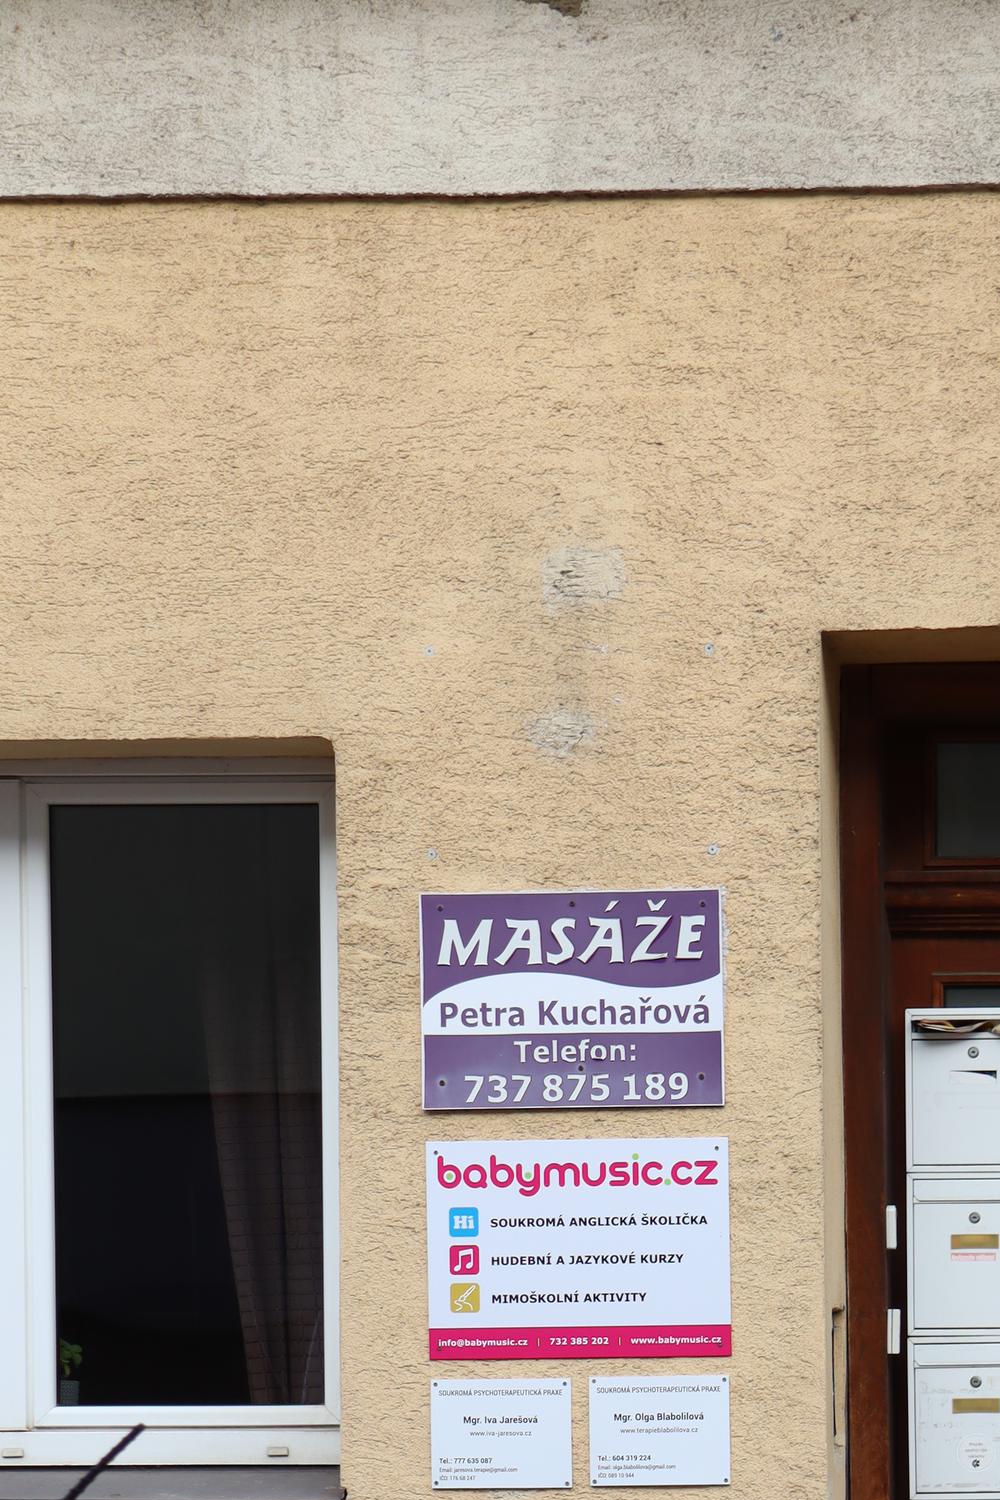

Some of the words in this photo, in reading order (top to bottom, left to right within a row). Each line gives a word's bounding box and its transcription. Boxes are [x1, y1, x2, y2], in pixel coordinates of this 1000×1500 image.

[437, 899, 706, 966] MASÁŽE
[440, 1002, 525, 1027] Petra
[538, 995, 710, 1026] Kuchařová
[513, 1039, 636, 1063] Telefon:
[464, 1075, 532, 1103] 737
[543, 1074, 610, 1101] 875
[623, 1072, 689, 1100] 189
[437, 1152, 718, 1197] babymusic.cz
[453, 1215, 475, 1230] Hi
[490, 1215, 565, 1228] SOUKROMÁ
[569, 1214, 637, 1227] ANGLICKÁ
[640, 1212, 708, 1226] ŠKOLIČKA
[491, 1252, 552, 1266] HUDEBNÍ
[556, 1255, 565, 1265] A
[568, 1252, 636, 1265] JAZYKOVÉ
[640, 1253, 684, 1264] KURZY
[491, 1290, 580, 1304] MIMOŠKOLNÍ
[583, 1292, 647, 1303] AKTIVITY
[438, 1338, 528, 1347] info@babymusic.cz
[549, 1337, 568, 1345] 732
[570, 1337, 589, 1345] 385
[591, 1336, 609, 1345] 202
[630, 1335, 722, 1345] www.babymusic.cz
[701, 1385, 721, 1393] PRAXE
[463, 1416, 482, 1425] Mgr.
[484, 1416, 497, 1424] Iva
[499, 1415, 538, 1424] Jarešová
[614, 1413, 633, 1423] Mgr.
[635, 1413, 655, 1423] Olga
[656, 1412, 704, 1421] Blabolilová
